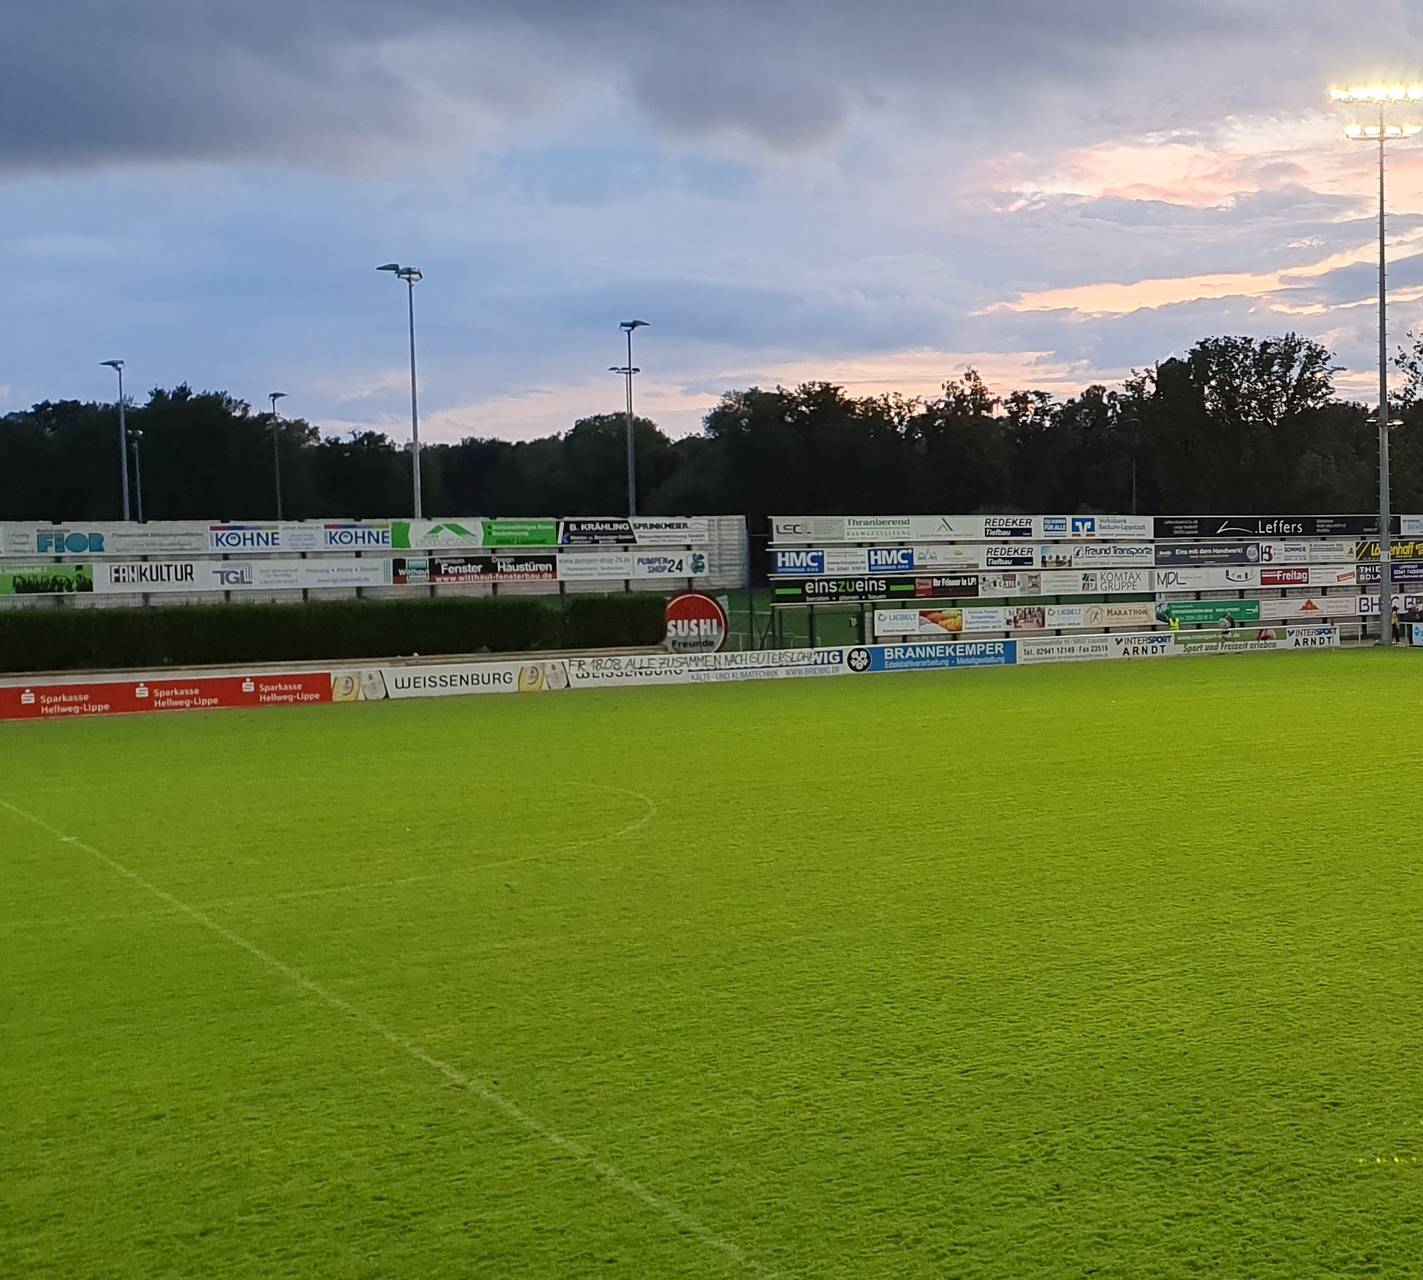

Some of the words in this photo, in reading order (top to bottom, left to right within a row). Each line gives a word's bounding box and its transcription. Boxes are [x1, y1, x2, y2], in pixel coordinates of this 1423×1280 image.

[985, 518, 1033, 527] REDEKER
[1259, 519, 1303, 533] Leffers
[215, 532, 280, 548] KÖHNE
[328, 530, 390, 545] KÖHNE
[870, 549, 909, 564] HMC
[986, 547, 1034, 556] REDEKER
[777, 551, 819, 567] HMC
[441, 563, 483, 574] Fenster
[497, 561, 553, 572] Haustüren
[668, 559, 684, 573] 24
[212, 570, 253, 585] TGL
[1100, 571, 1142, 581] KOMTAX
[1276, 570, 1308, 583] Freitag
[805, 579, 887, 594] einszueins
[1100, 581, 1137, 591] GRUPPE
[1107, 608, 1148, 616] MARATHON
[667, 618, 718, 637] SUSHI
[671, 639, 715, 648] Freunde
[1124, 635, 1172, 645] INTERSPORT
[1294, 636, 1332, 647] ARNDT
[884, 643, 1004, 660] BRANNEKEMPER
[1122, 645, 1166, 656] ARNDT
[1183, 643, 1203, 654] Sport
[1205, 643, 1219, 651] und
[1249, 641, 1277, 649] erleben
[394, 672, 513, 690] WEISSENBURG
[154, 687, 200, 698] Sparkasse
[259, 682, 303, 693] Sparkasse
[40, 693, 90, 704] Sparkasse
[154, 696, 219, 708] Hellweg-Lippe
[259, 691, 320, 702] Hellweg-Lippe
[41, 702, 110, 714] Hellweg-Lippe
